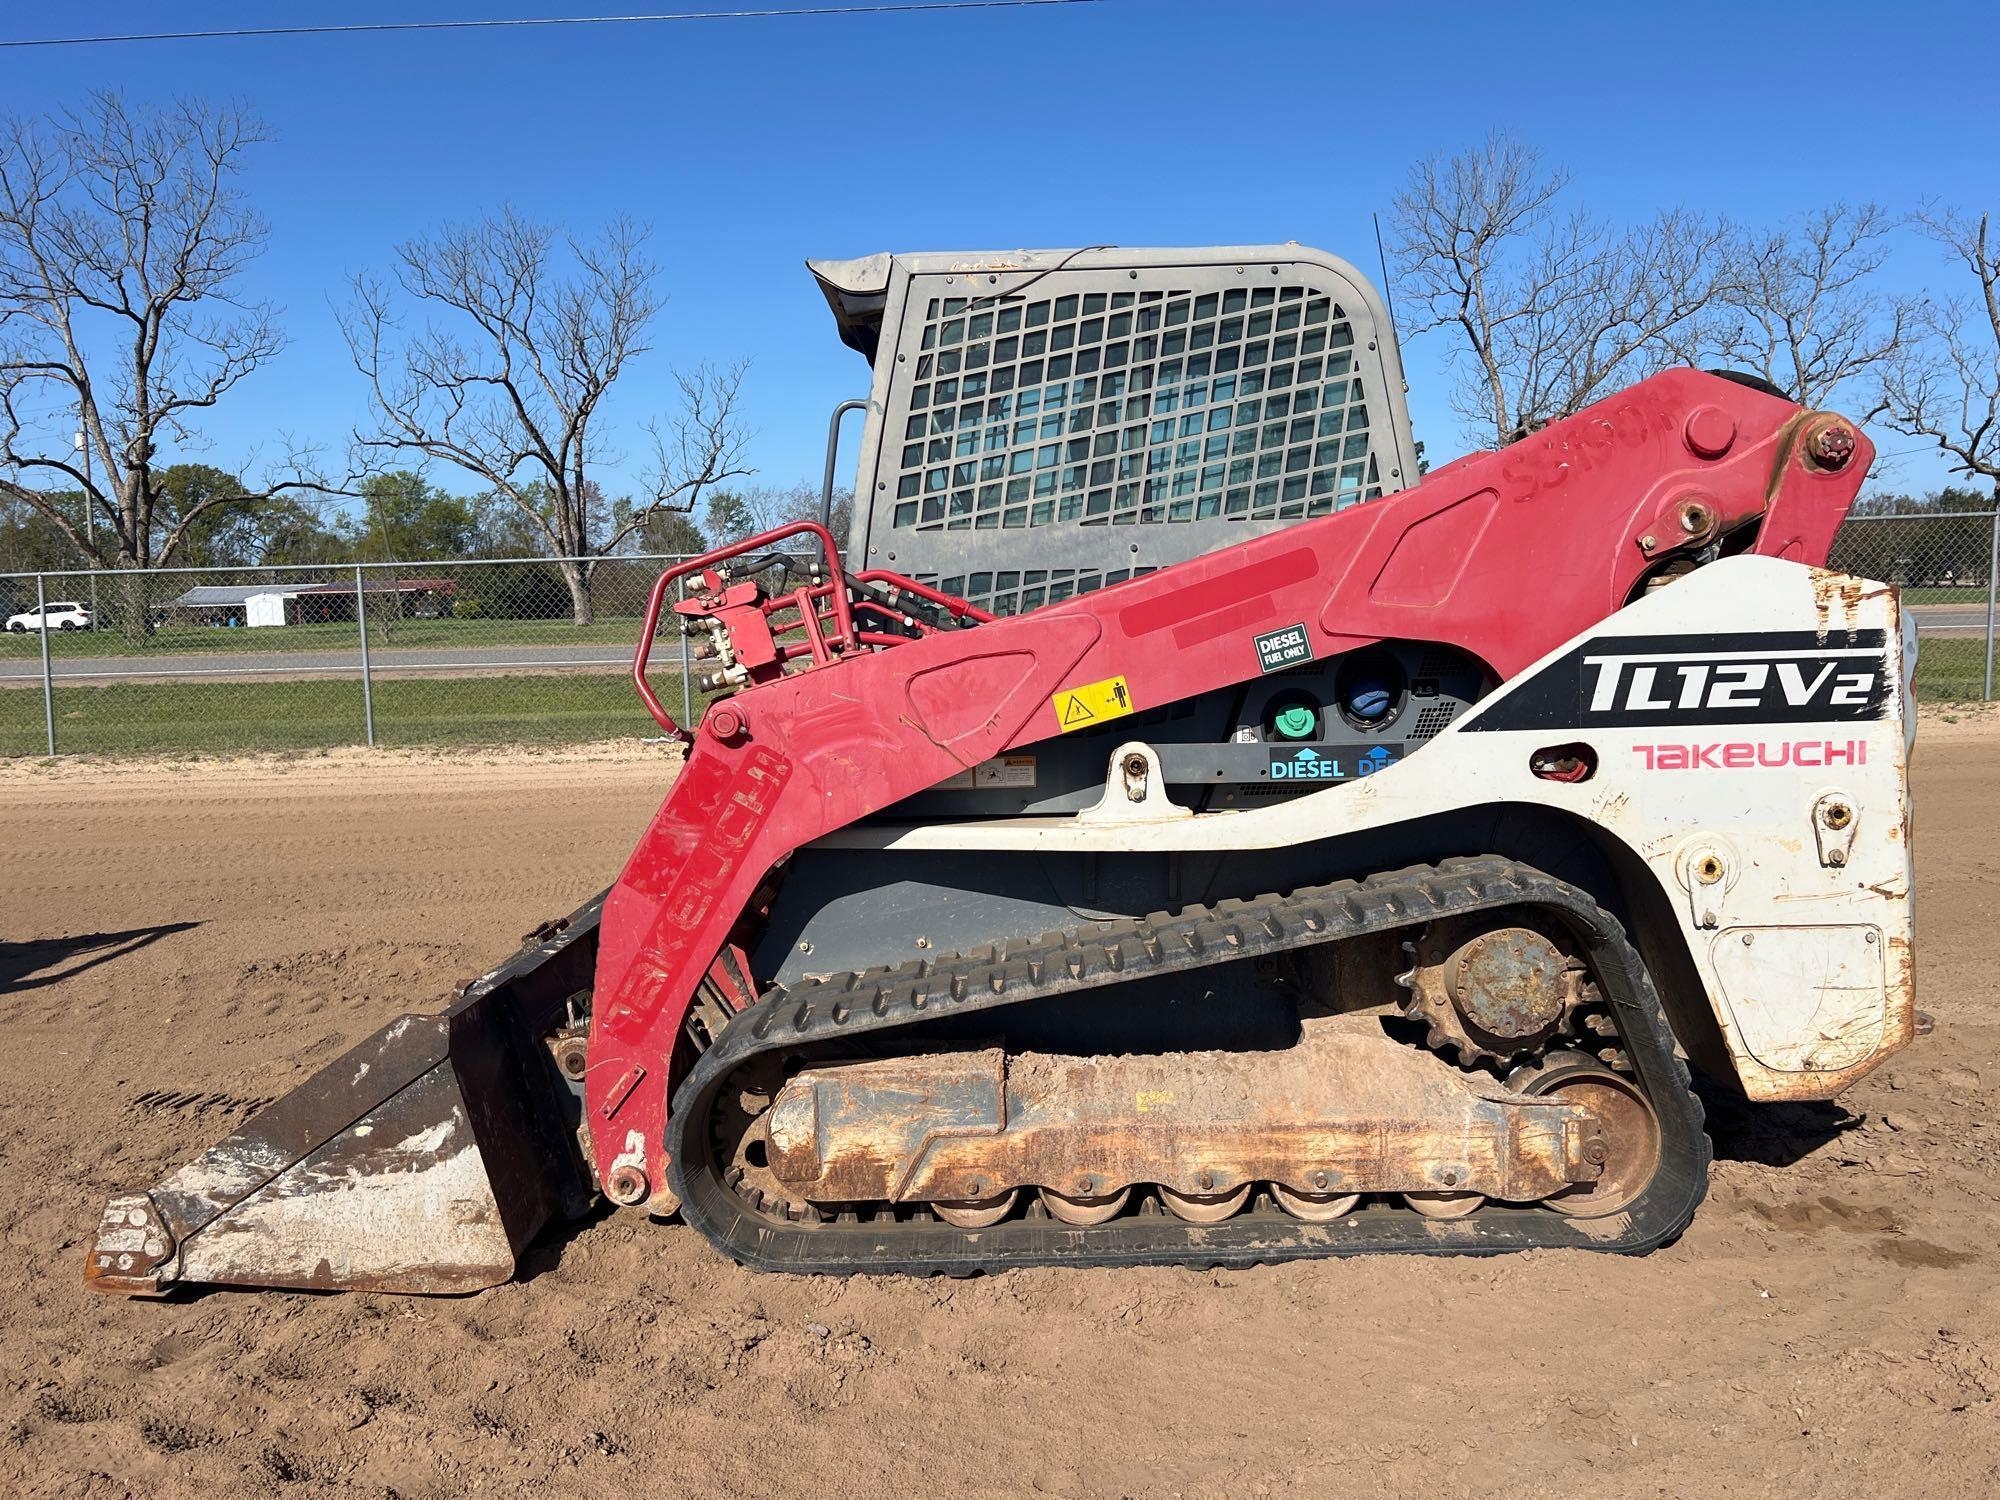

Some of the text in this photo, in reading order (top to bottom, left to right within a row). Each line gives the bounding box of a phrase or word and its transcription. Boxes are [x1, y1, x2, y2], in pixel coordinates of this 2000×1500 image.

[1259, 631, 1304, 654] DIESEL
[1264, 645, 1305, 665] FUEL ONLY
[1583, 649, 1885, 712] TL12V2
[1271, 760, 1345, 779] DIESEL
